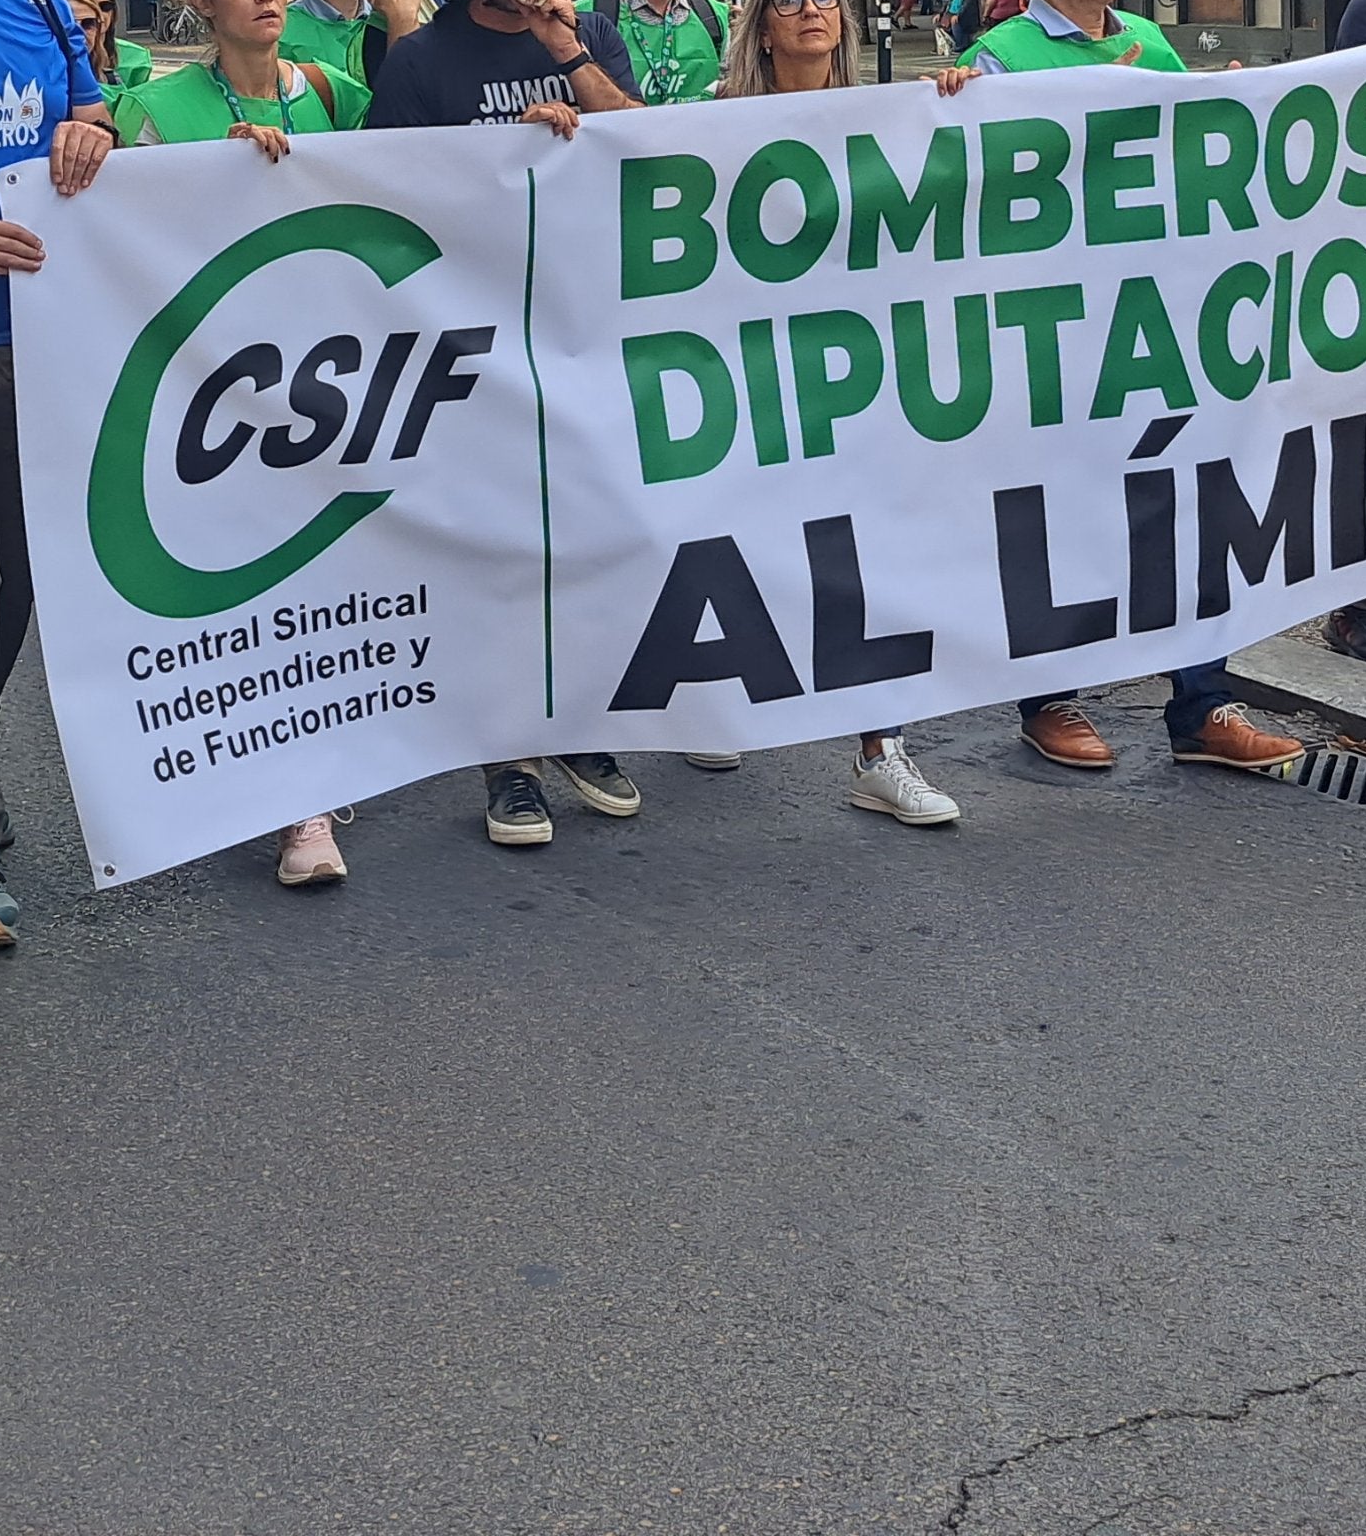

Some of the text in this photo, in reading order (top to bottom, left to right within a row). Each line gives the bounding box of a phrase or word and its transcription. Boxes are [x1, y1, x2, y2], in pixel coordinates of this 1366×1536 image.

[479, 74, 580, 114] JUANOT
[647, 73, 687, 96] CIF
[174, 324, 497, 486] CSIF
[127, 584, 428, 682] Central Sindical
[607, 513, 934, 712] AL
[136, 636, 432, 734] Independiente y
[152, 675, 438, 784] de Funcionarios
